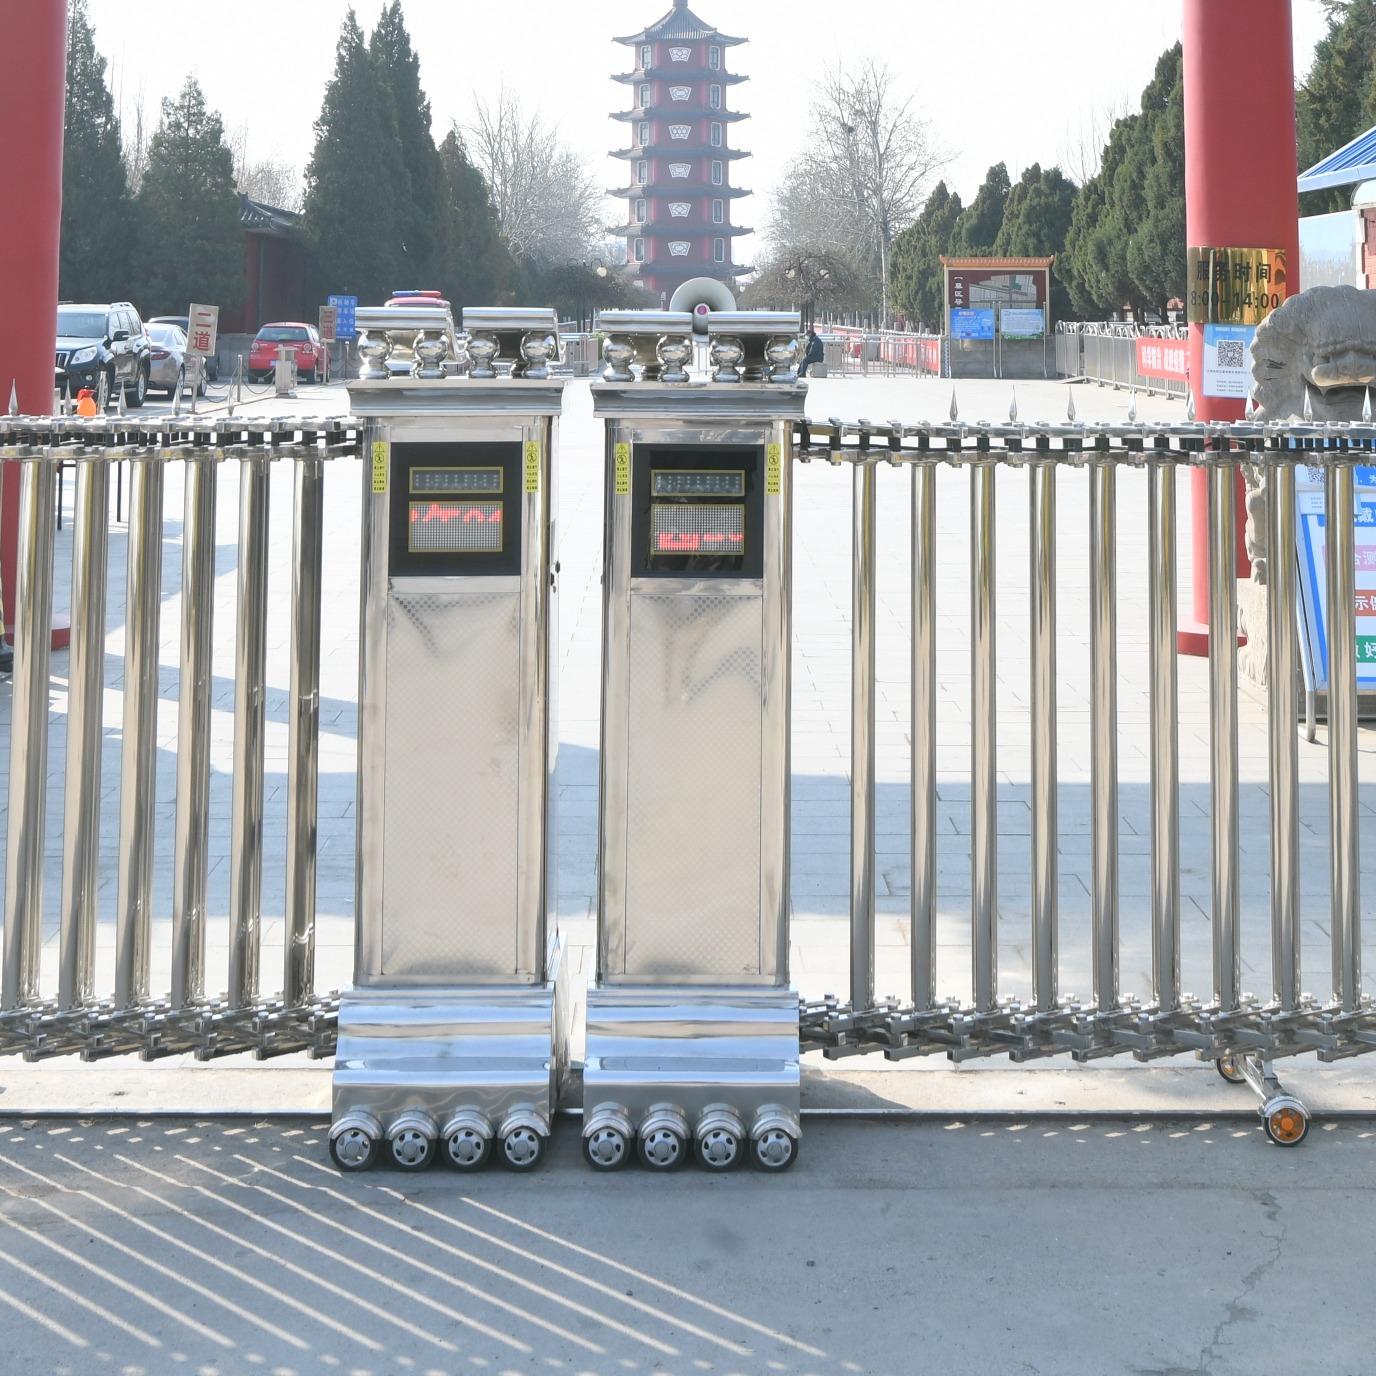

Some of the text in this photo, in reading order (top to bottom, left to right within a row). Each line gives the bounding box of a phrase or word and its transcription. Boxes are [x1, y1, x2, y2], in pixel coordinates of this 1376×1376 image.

[1196, 260, 1272, 283] 服务时间
[192, 312, 212, 352] 二道
